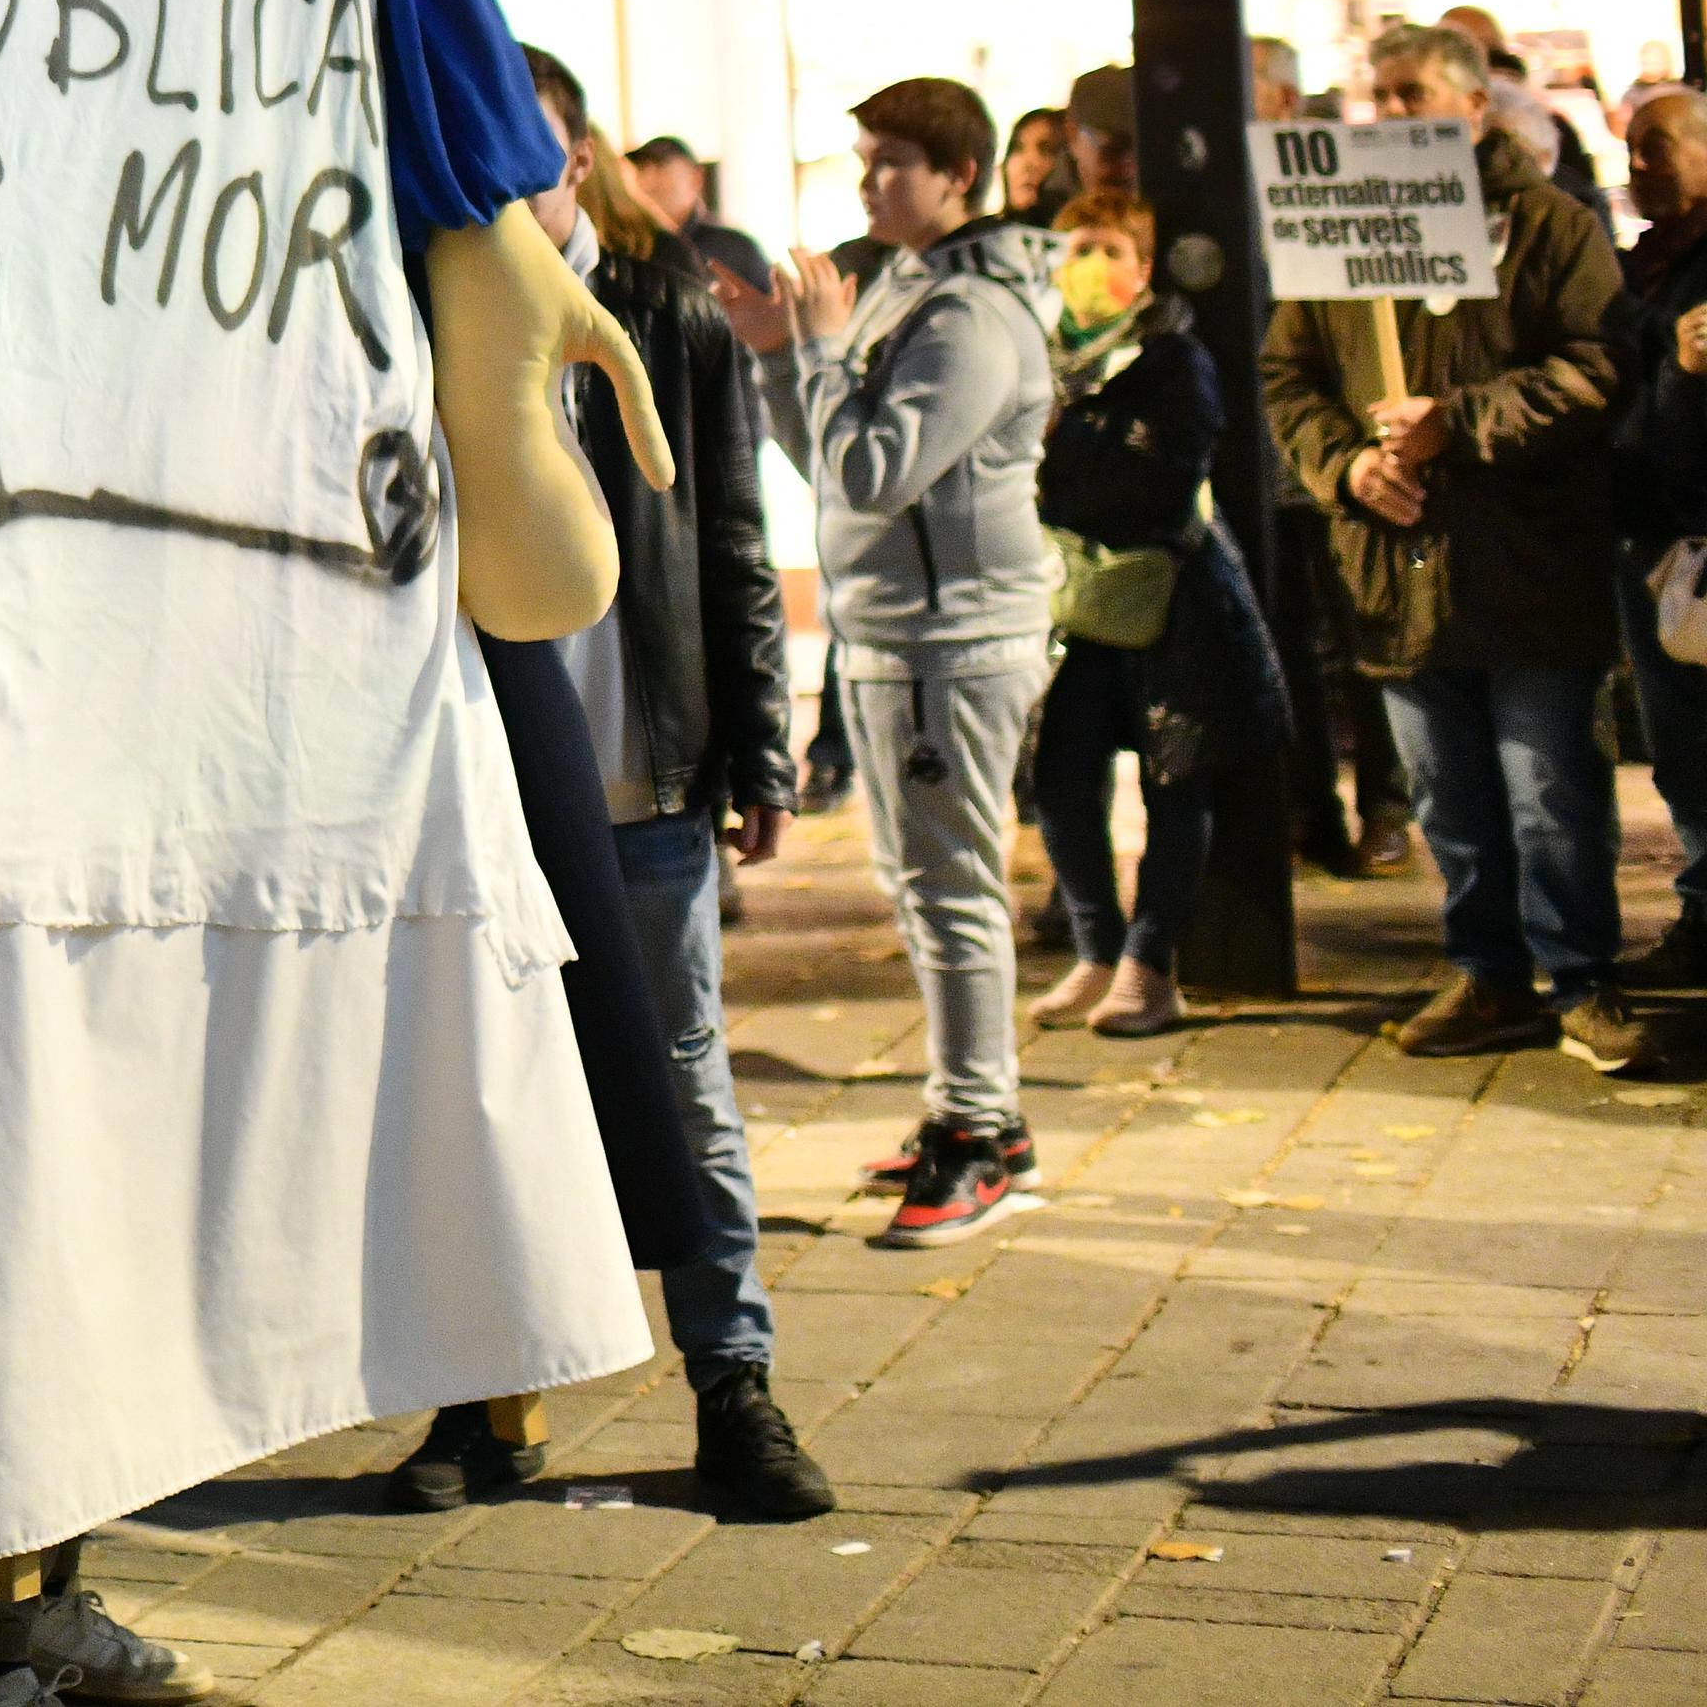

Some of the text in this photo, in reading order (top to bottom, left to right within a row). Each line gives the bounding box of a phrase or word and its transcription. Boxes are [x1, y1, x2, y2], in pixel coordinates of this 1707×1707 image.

[1273, 130, 1339, 177] no
[1302, 211, 1422, 245] serveis
[99, 138, 392, 373] MOR
